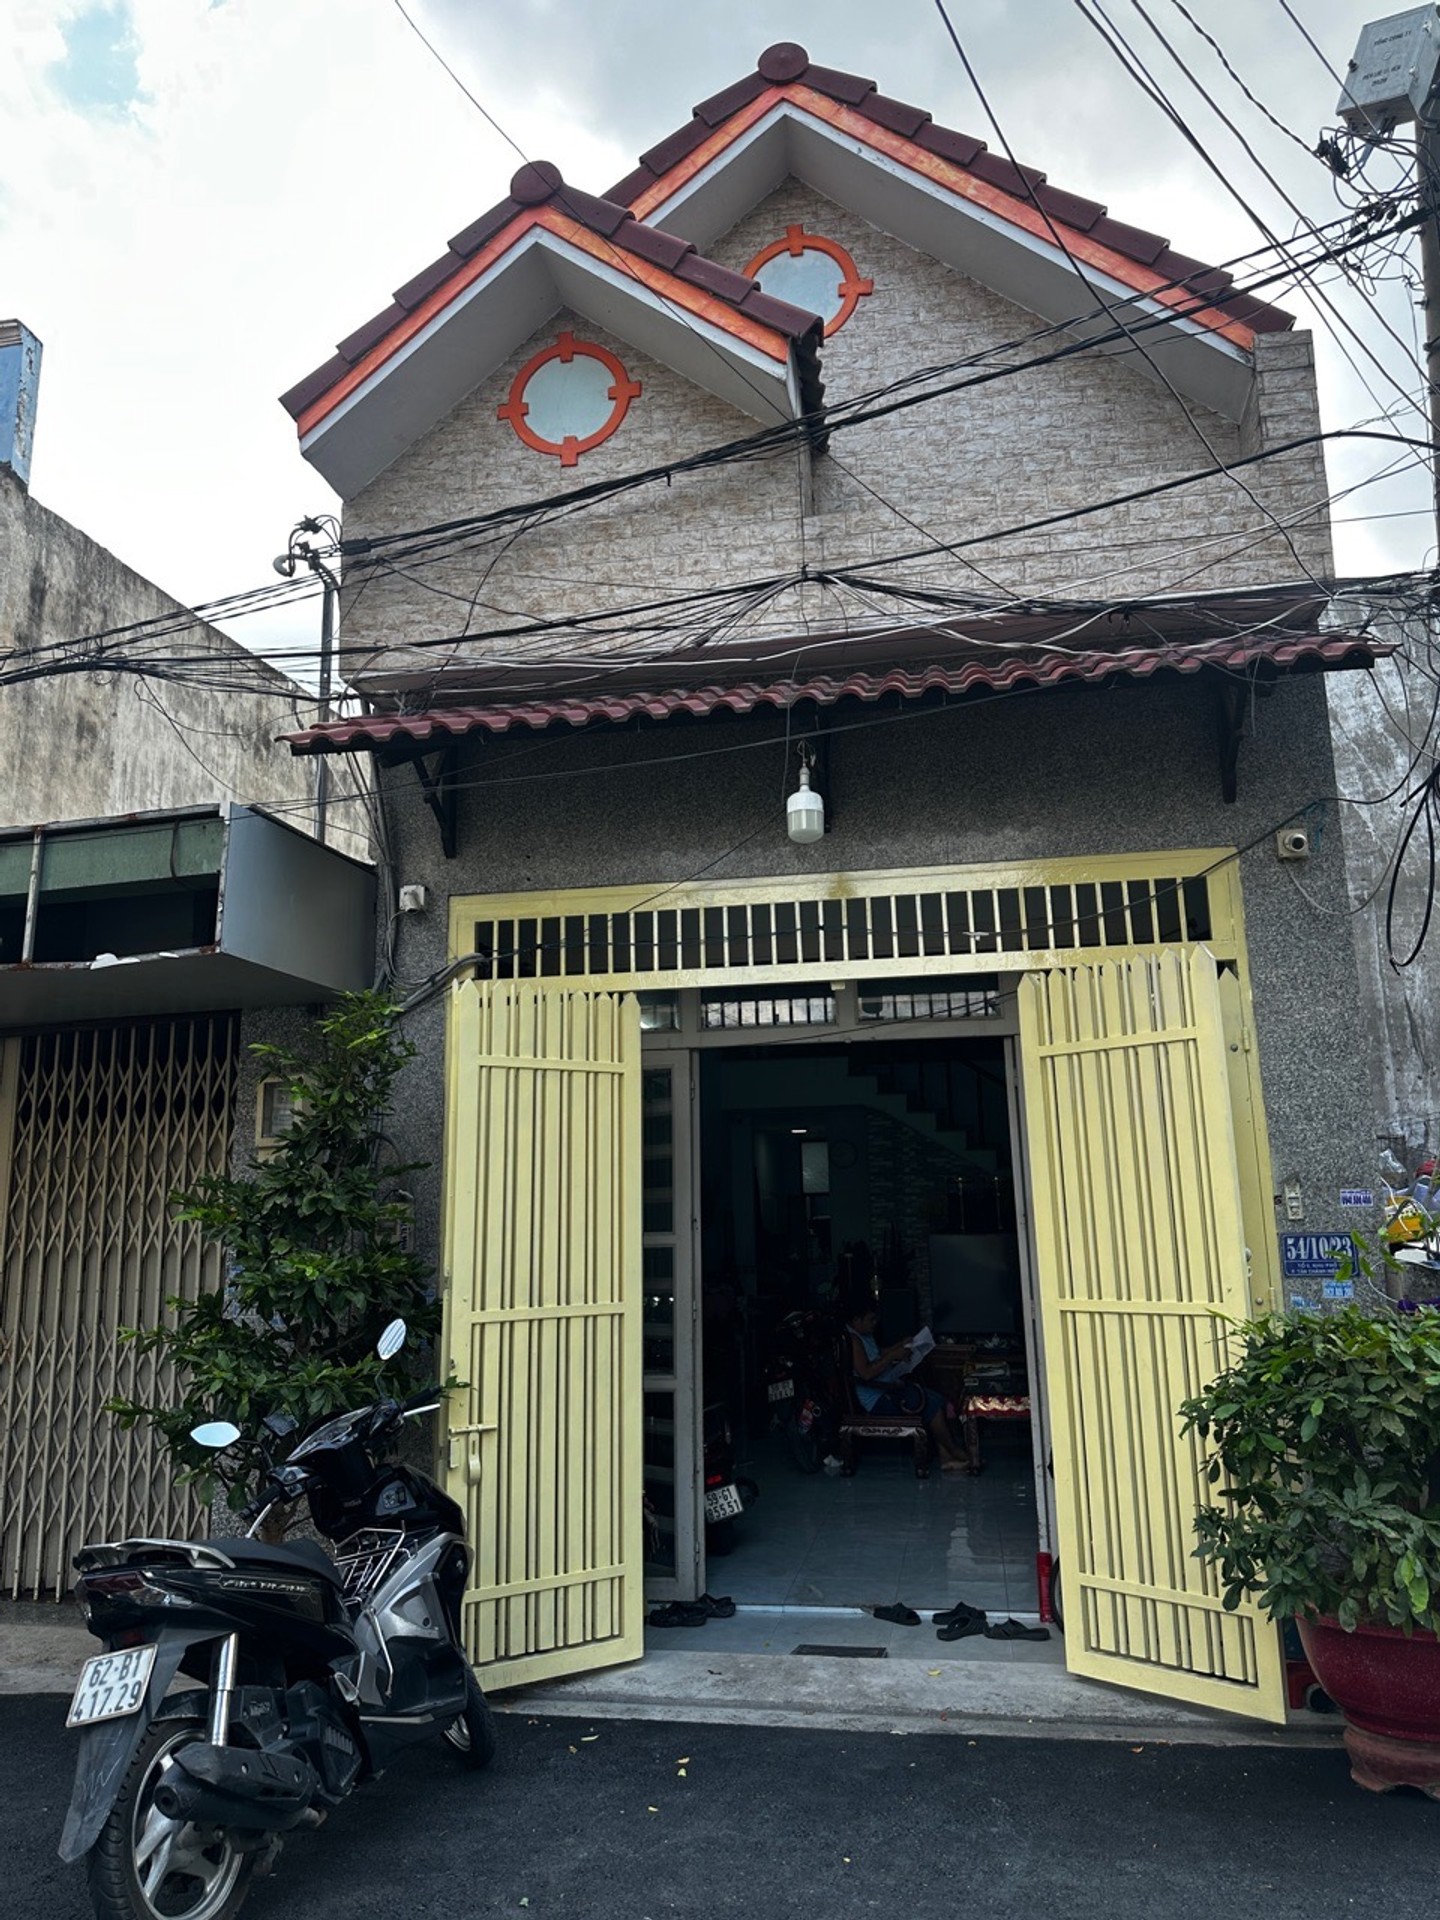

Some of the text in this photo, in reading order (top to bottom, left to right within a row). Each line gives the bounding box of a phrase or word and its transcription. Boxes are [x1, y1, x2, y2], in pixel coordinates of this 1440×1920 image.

[1286, 1236, 1353, 1259] 54/10/23
[89, 1651, 143, 1688] 62-B1
[73, 1680, 142, 1720] 417.29
